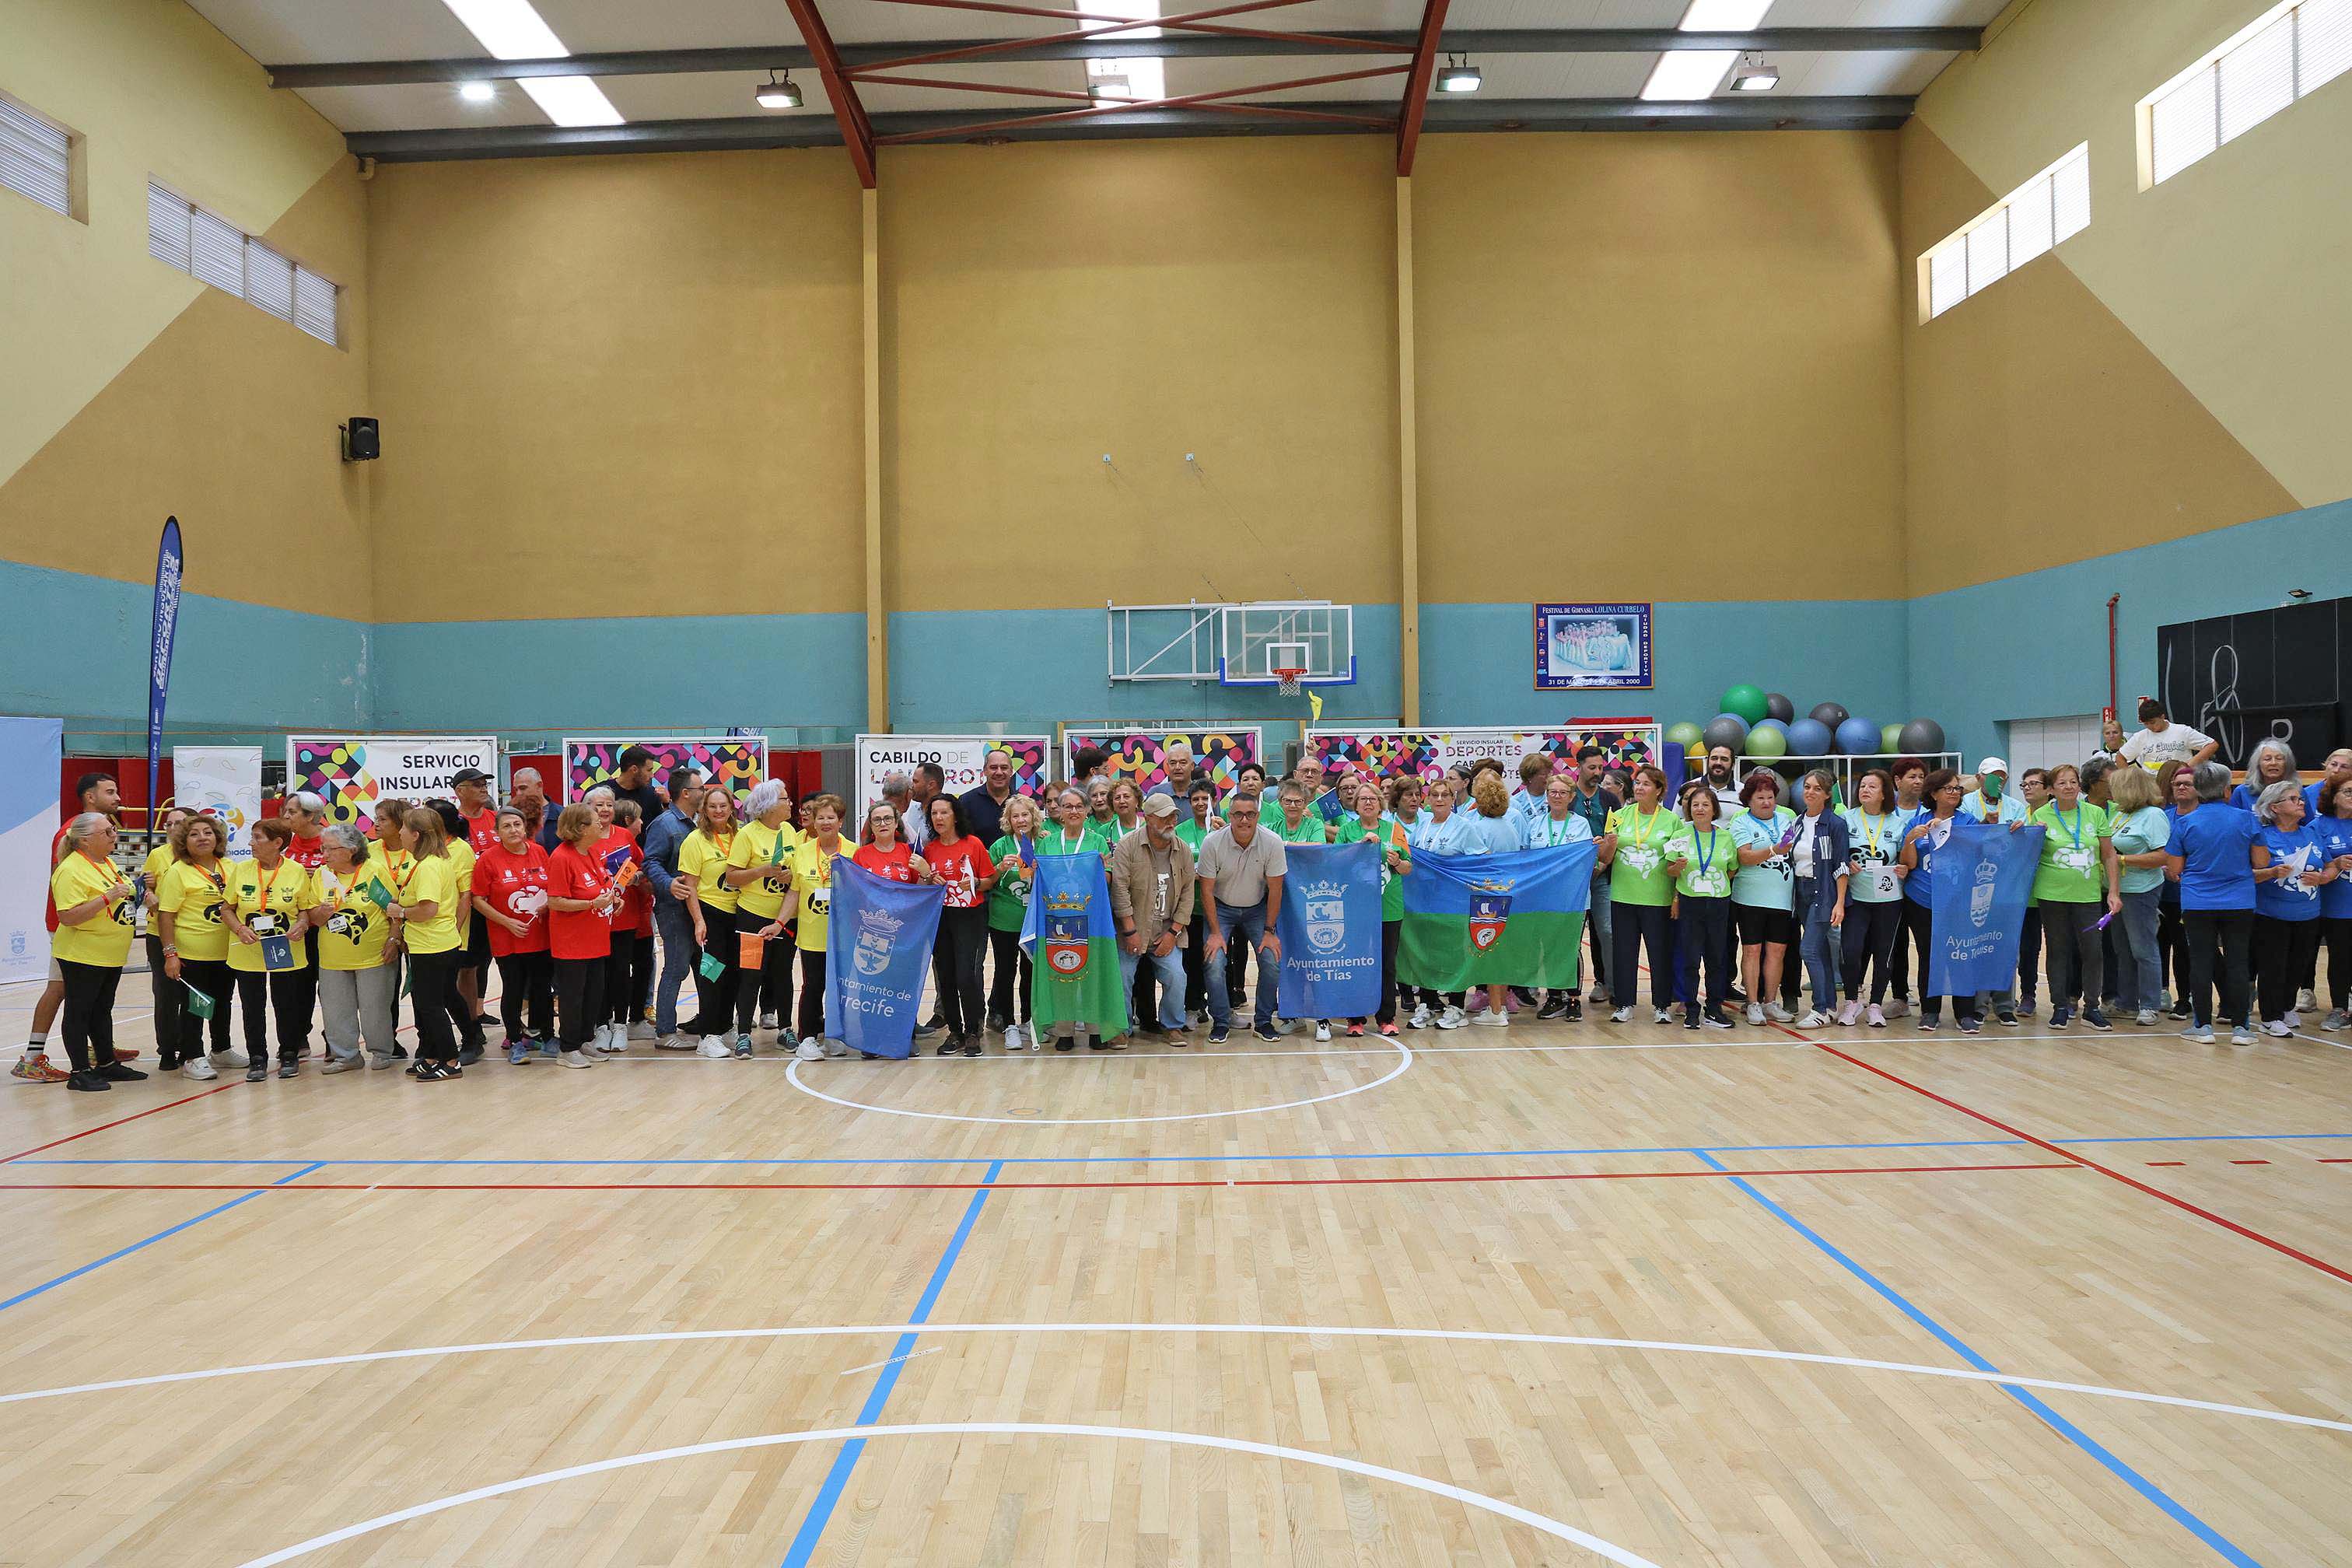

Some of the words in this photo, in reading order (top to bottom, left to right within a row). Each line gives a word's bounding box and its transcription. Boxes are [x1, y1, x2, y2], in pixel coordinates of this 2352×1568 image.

[1594, 605, 1616, 614] LOLINA
[870, 751, 942, 764] CABILDO
[947, 751, 970, 764] DE
[1446, 745, 1522, 758] DEPORTES
[402, 754, 481, 768] SERVICIO
[1951, 949, 1968, 961] de
[1286, 955, 1375, 971] Ayuntamiento
[1306, 970, 1321, 982] de
[1324, 969, 1352, 981] Tías
[896, 989, 912, 1001] de
[839, 994, 894, 1017] rrecife
